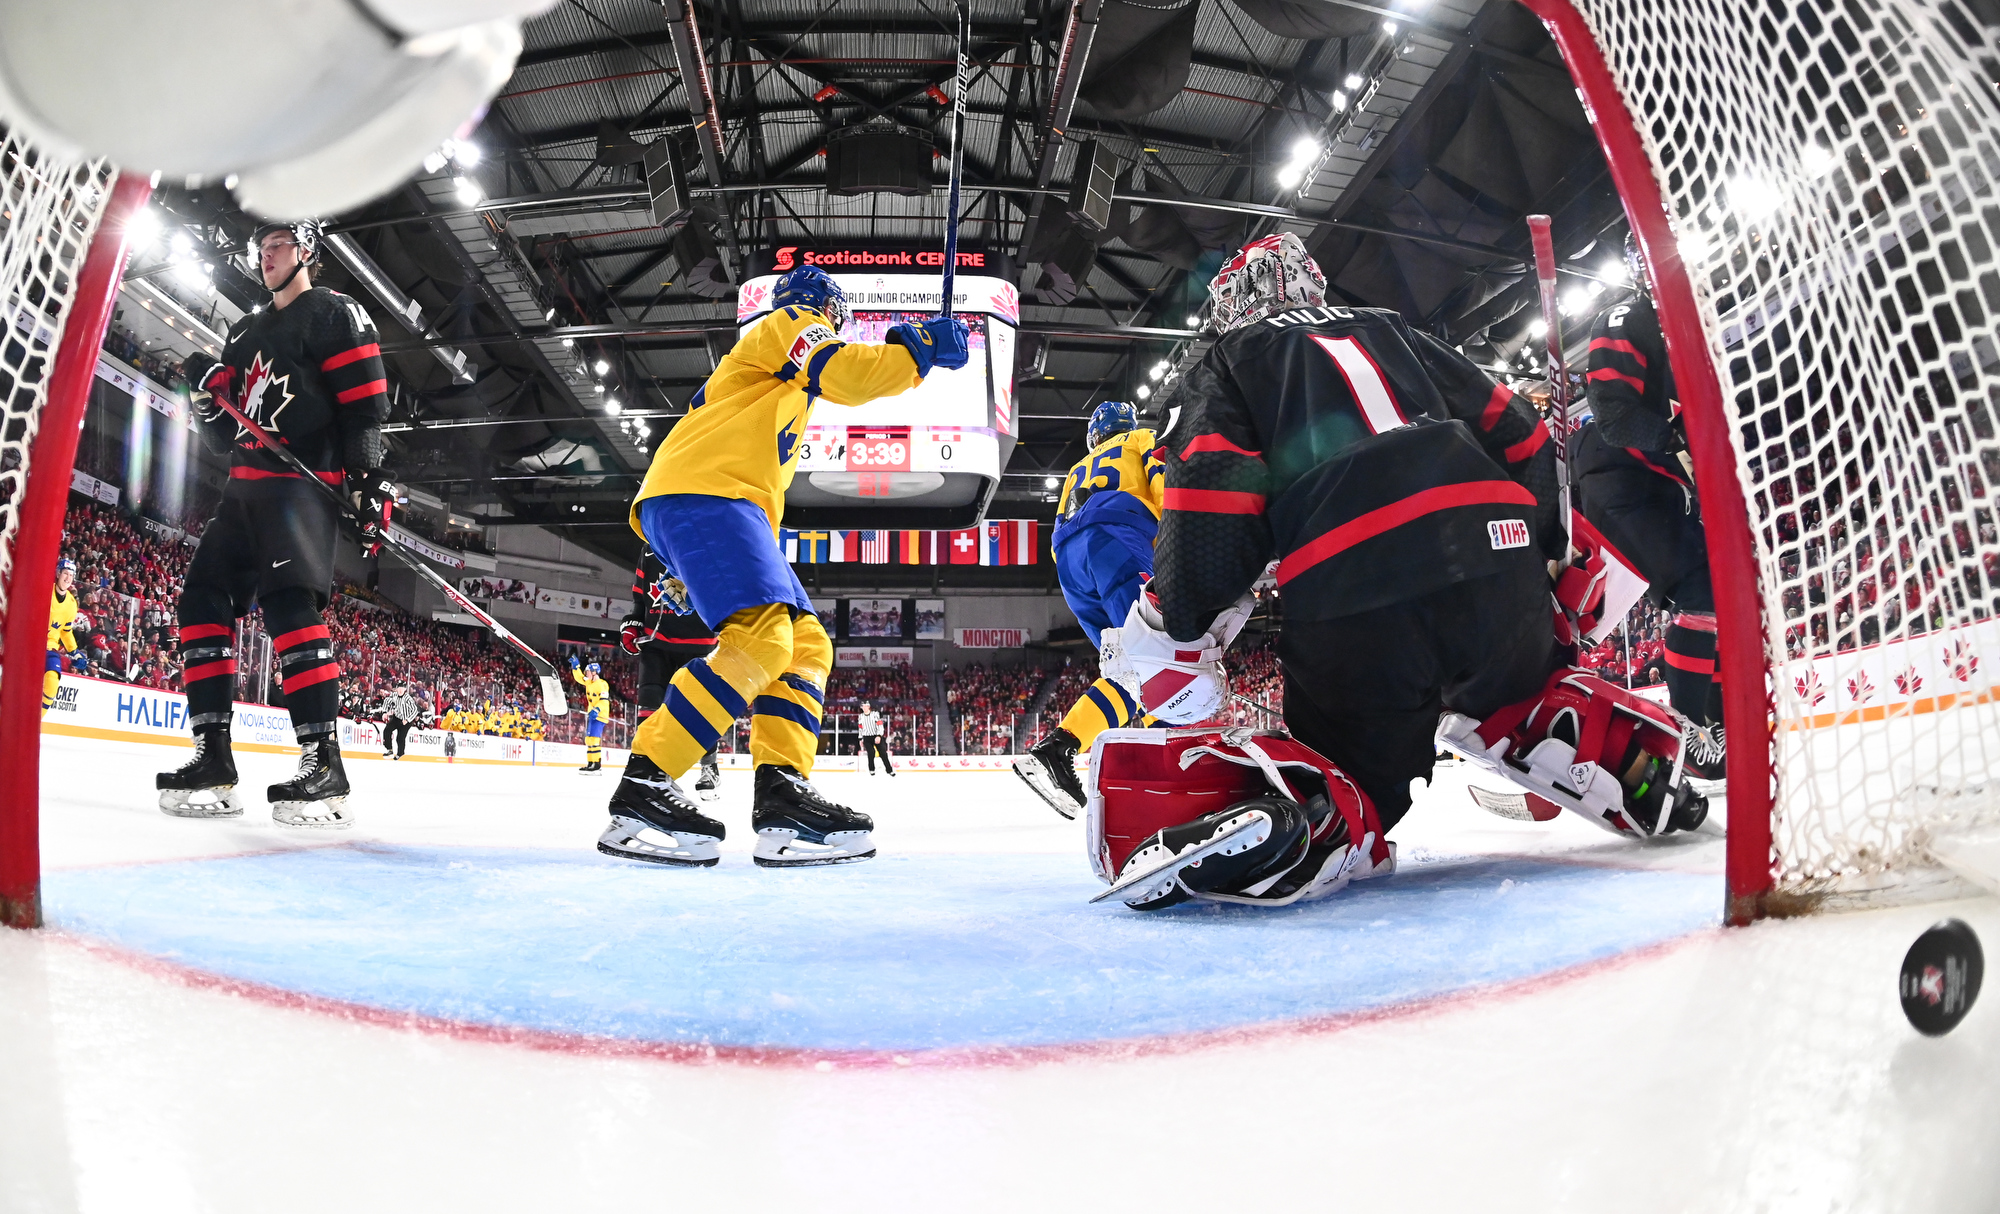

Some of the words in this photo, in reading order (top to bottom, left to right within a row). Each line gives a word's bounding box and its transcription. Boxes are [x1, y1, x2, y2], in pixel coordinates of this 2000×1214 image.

[956, 52, 969, 116] BAUER
[803, 251, 912, 266] Scotiabank
[843, 292, 863, 304] ORLD
[866, 292, 898, 304] JUNIOR
[900, 292, 968, 305] CHAMPIOHIP
[347, 303, 379, 334] 14
[1308, 333, 1409, 436] 1
[1549, 366, 1566, 463] BAUER
[800, 443, 811, 460] 3
[851, 442, 906, 465] 3:39
[941, 444, 952, 460] 0
[1068, 445, 1122, 492] 25
[145, 521, 154, 531] 23
[1499, 522, 1527, 545] IIHF
[962, 629, 1022, 647] MONCTON
[55, 685, 79, 702] CKEY
[1167, 689, 1193, 710] MACH
[58, 701, 77, 712] SCOTIA
[117, 693, 190, 730] HALIFA
[239, 712, 265, 728] NOVA
[266, 716, 294, 732] SCOTI
[255, 732, 282, 743] CANADA
[353, 728, 373, 745] IIHF
[419, 734, 442, 745] TISSOT
[467, 739, 485, 749] TISSOT
[505, 744, 522, 759] IIHF
